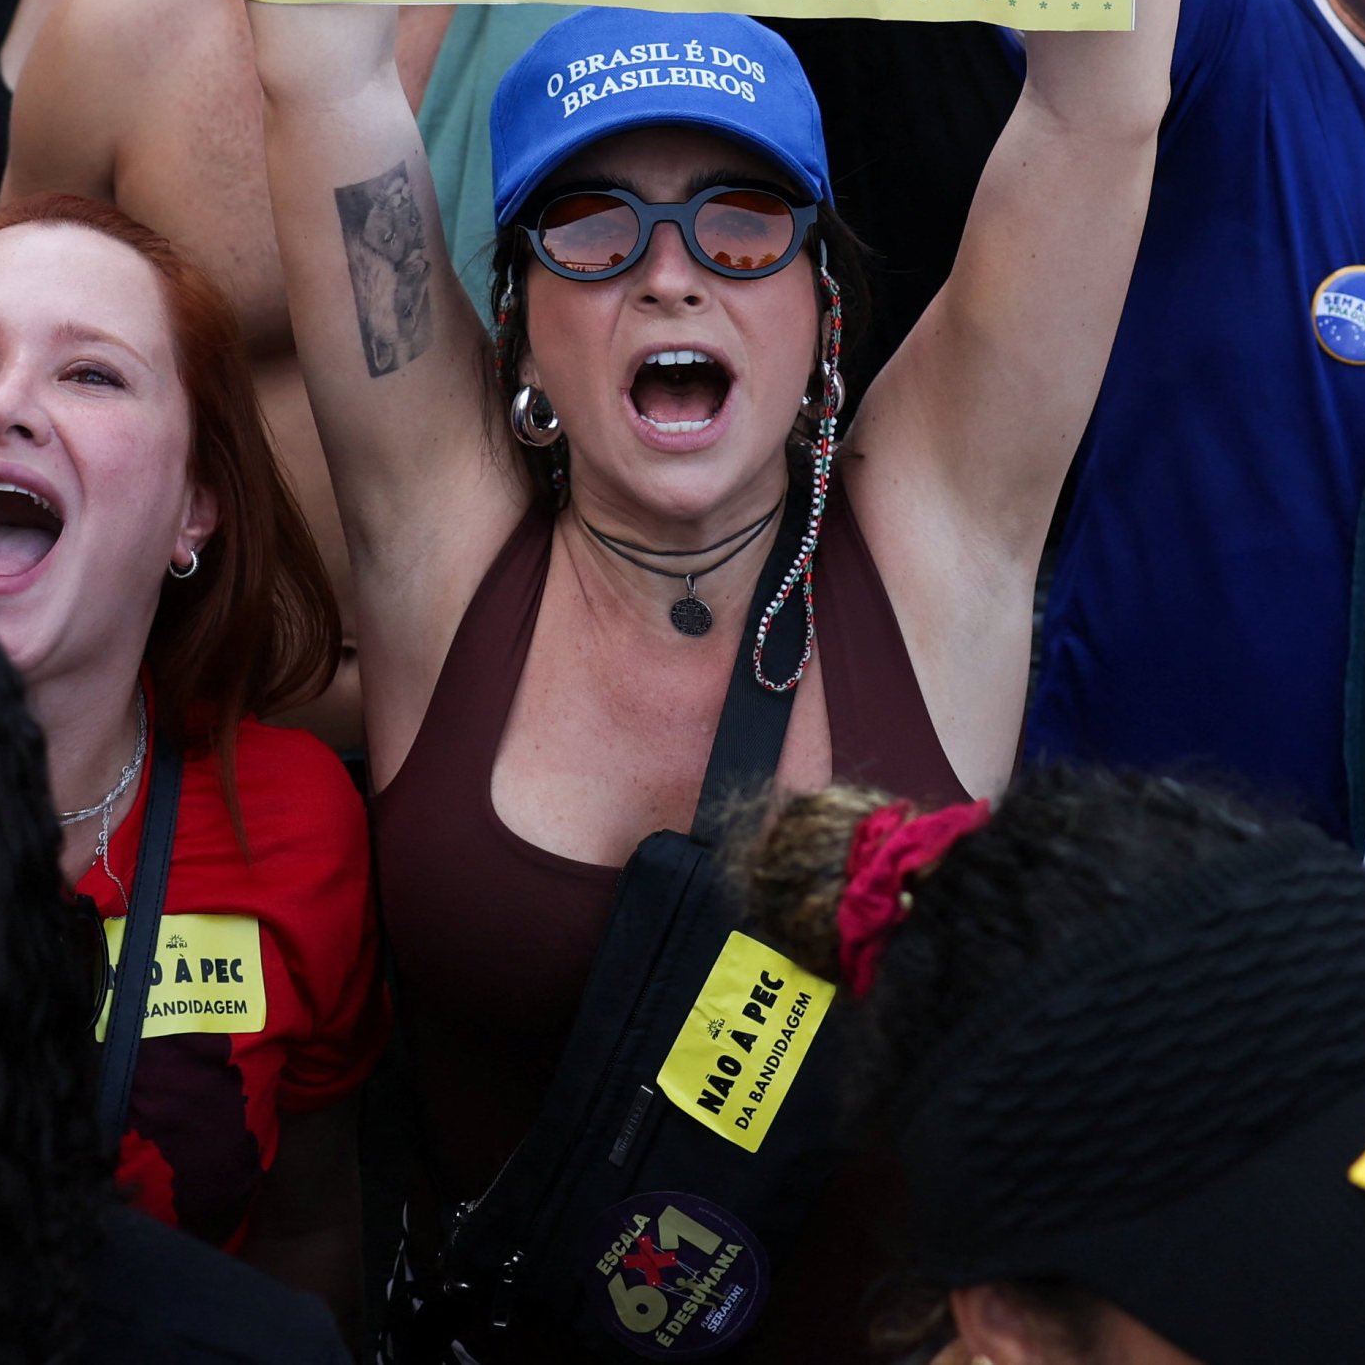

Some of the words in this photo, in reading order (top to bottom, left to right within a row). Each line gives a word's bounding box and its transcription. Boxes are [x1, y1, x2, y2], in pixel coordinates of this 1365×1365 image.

[547, 73, 564, 98] O
[567, 42, 679, 85] BRASIL
[683, 40, 706, 62] É
[709, 46, 766, 83] DOS
[562, 67, 756, 119] BRASILEIROS
[1323, 294, 1353, 310] SEM
[175, 953, 192, 983] À
[200, 958, 243, 983] PEC
[696, 1054, 742, 1115] NÃO
[727, 1028, 757, 1054] À
[742, 970, 785, 1026] PEC
[735, 1107, 757, 1130] DA
[748, 991, 812, 1105] BANDIDAGEM
[595, 1214, 651, 1275] ESCALA
[655, 1330, 674, 1347] É
[666, 1244, 744, 1336] DESUMANA
[708, 1284, 744, 1333] SERAFINI
